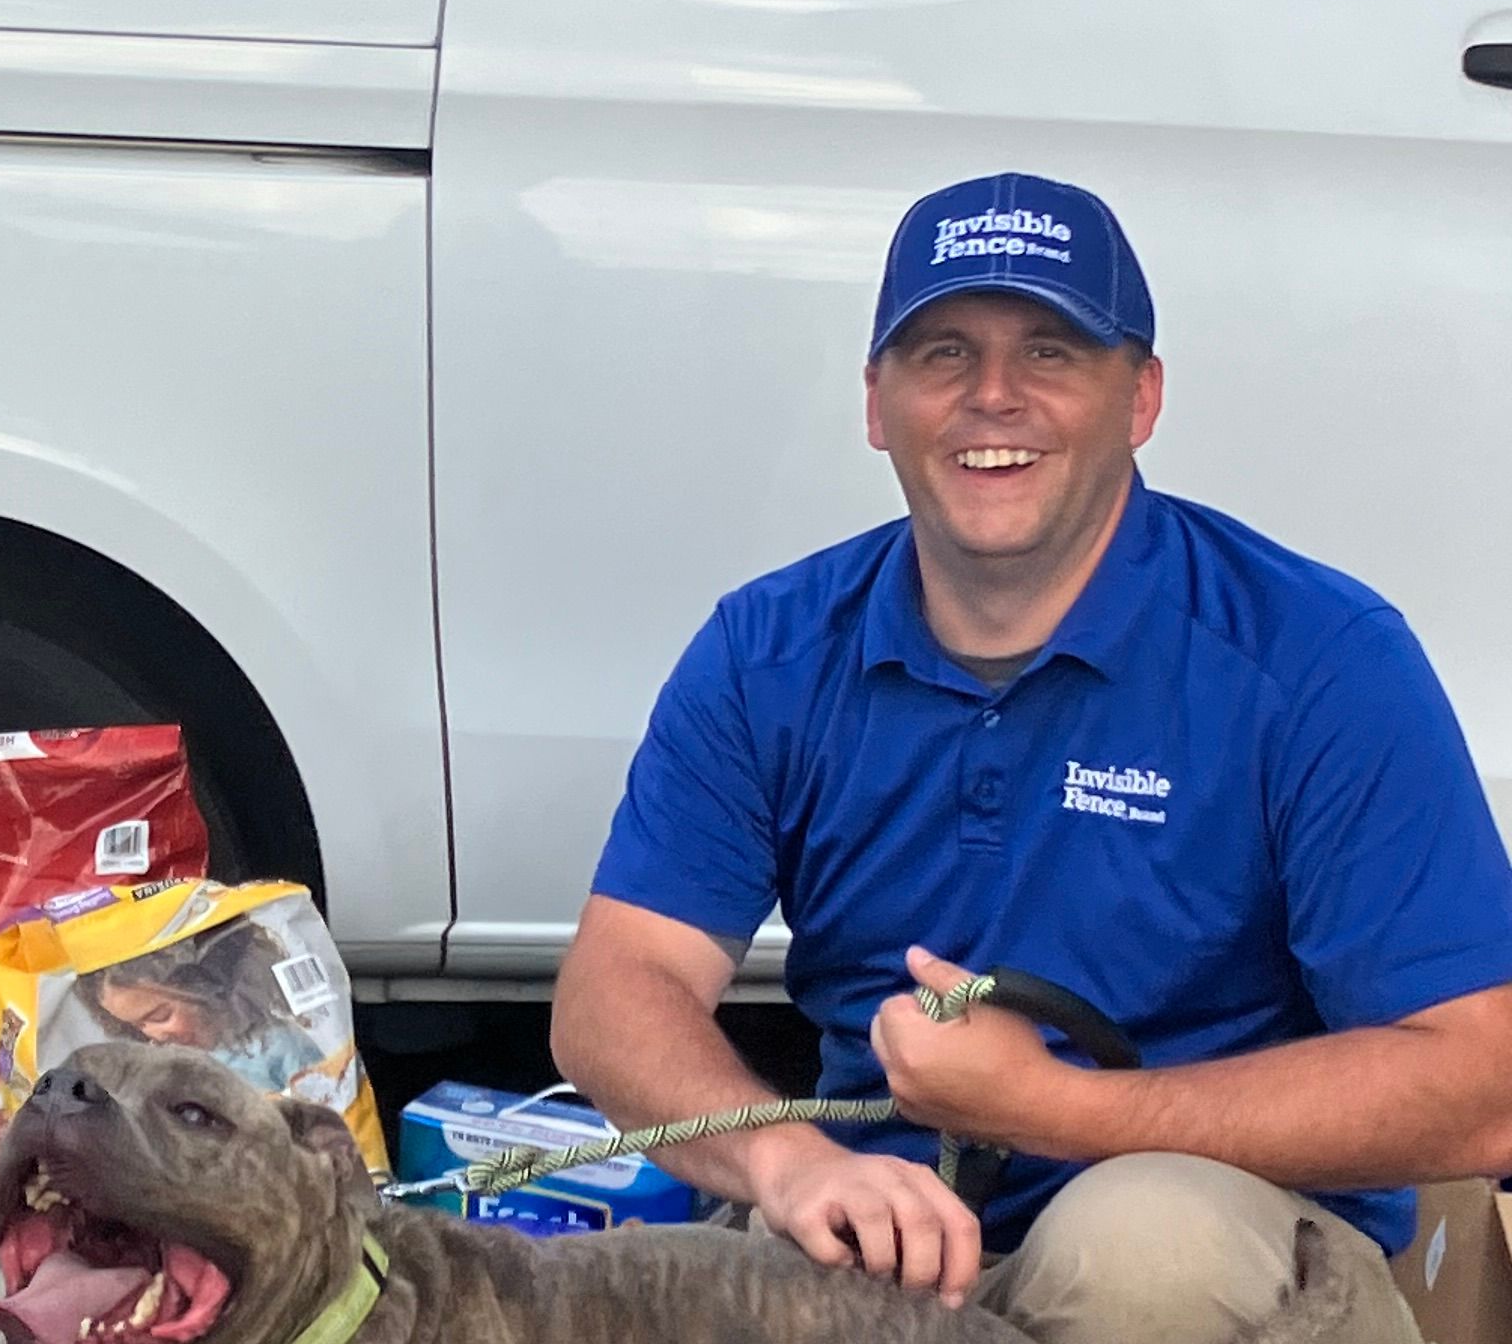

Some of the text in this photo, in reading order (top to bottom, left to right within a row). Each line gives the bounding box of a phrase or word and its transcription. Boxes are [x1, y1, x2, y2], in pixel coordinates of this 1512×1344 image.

[935, 208, 1072, 244] Invisible
[930, 235, 1026, 266] Fence
[1065, 760, 1171, 797] Invisible
[1062, 785, 1126, 818] Fence
